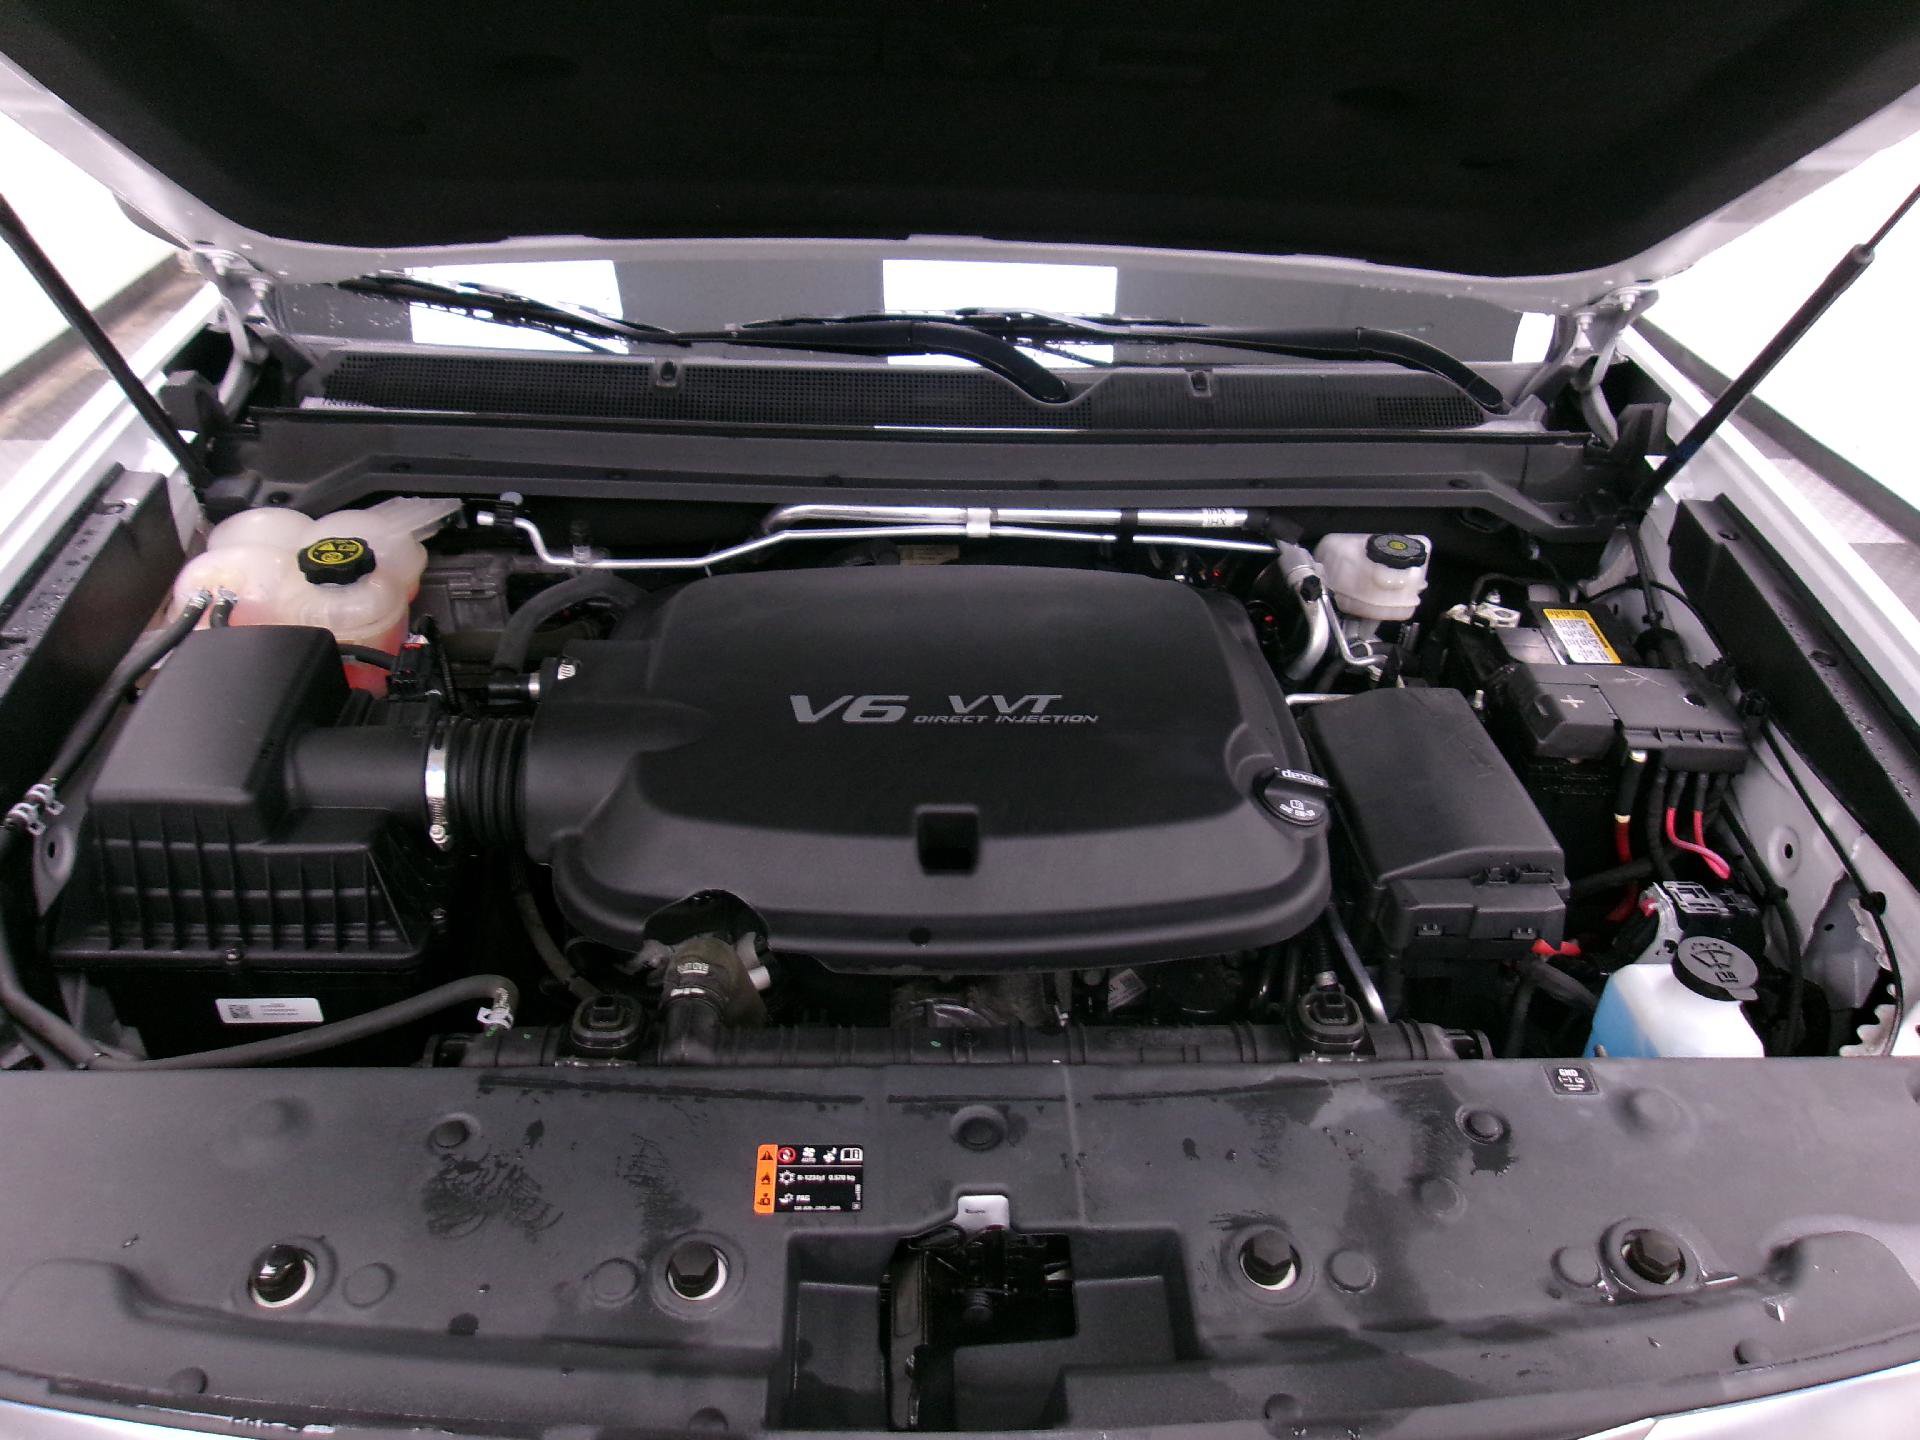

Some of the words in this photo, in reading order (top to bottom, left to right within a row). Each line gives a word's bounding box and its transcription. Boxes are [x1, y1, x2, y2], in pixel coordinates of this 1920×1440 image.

[790, 695, 909, 722] V6
[948, 695, 1062, 714] VVT
[913, 715, 988, 724] DIRECT
[995, 715, 1098, 724] INJECTION
